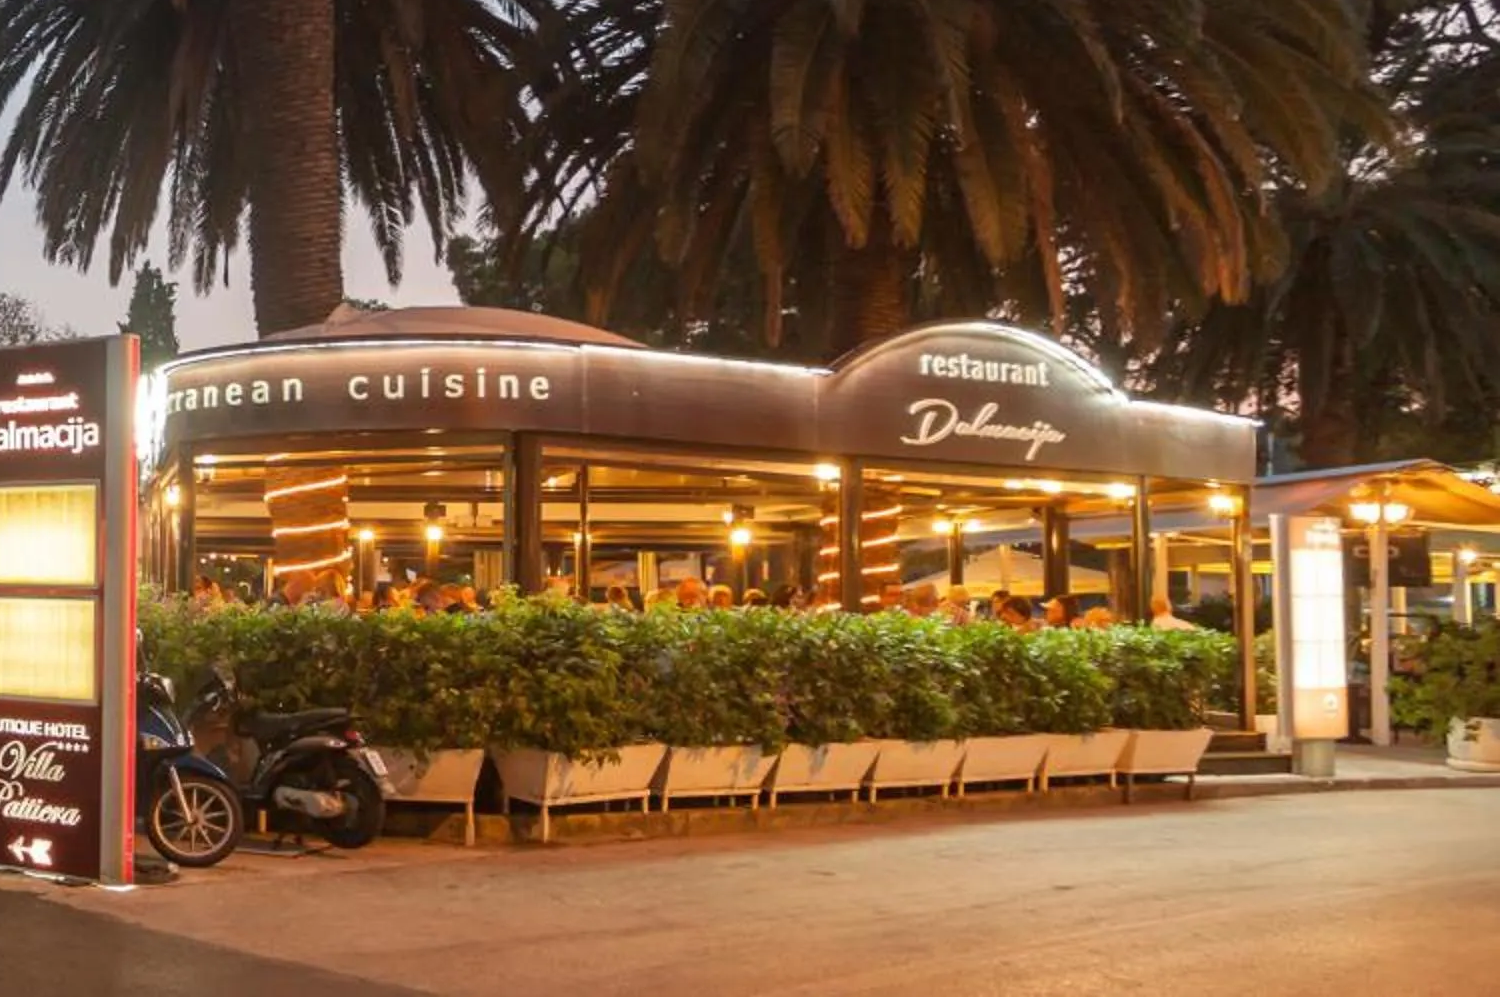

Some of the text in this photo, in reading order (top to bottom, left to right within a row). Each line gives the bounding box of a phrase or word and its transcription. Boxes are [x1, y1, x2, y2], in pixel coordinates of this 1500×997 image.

[349, 367, 549, 400] cuisine
[919, 353, 1050, 387] restaurant
[900, 398, 1067, 461] Dalmacija
[44, 722, 91, 741] HOTEL
